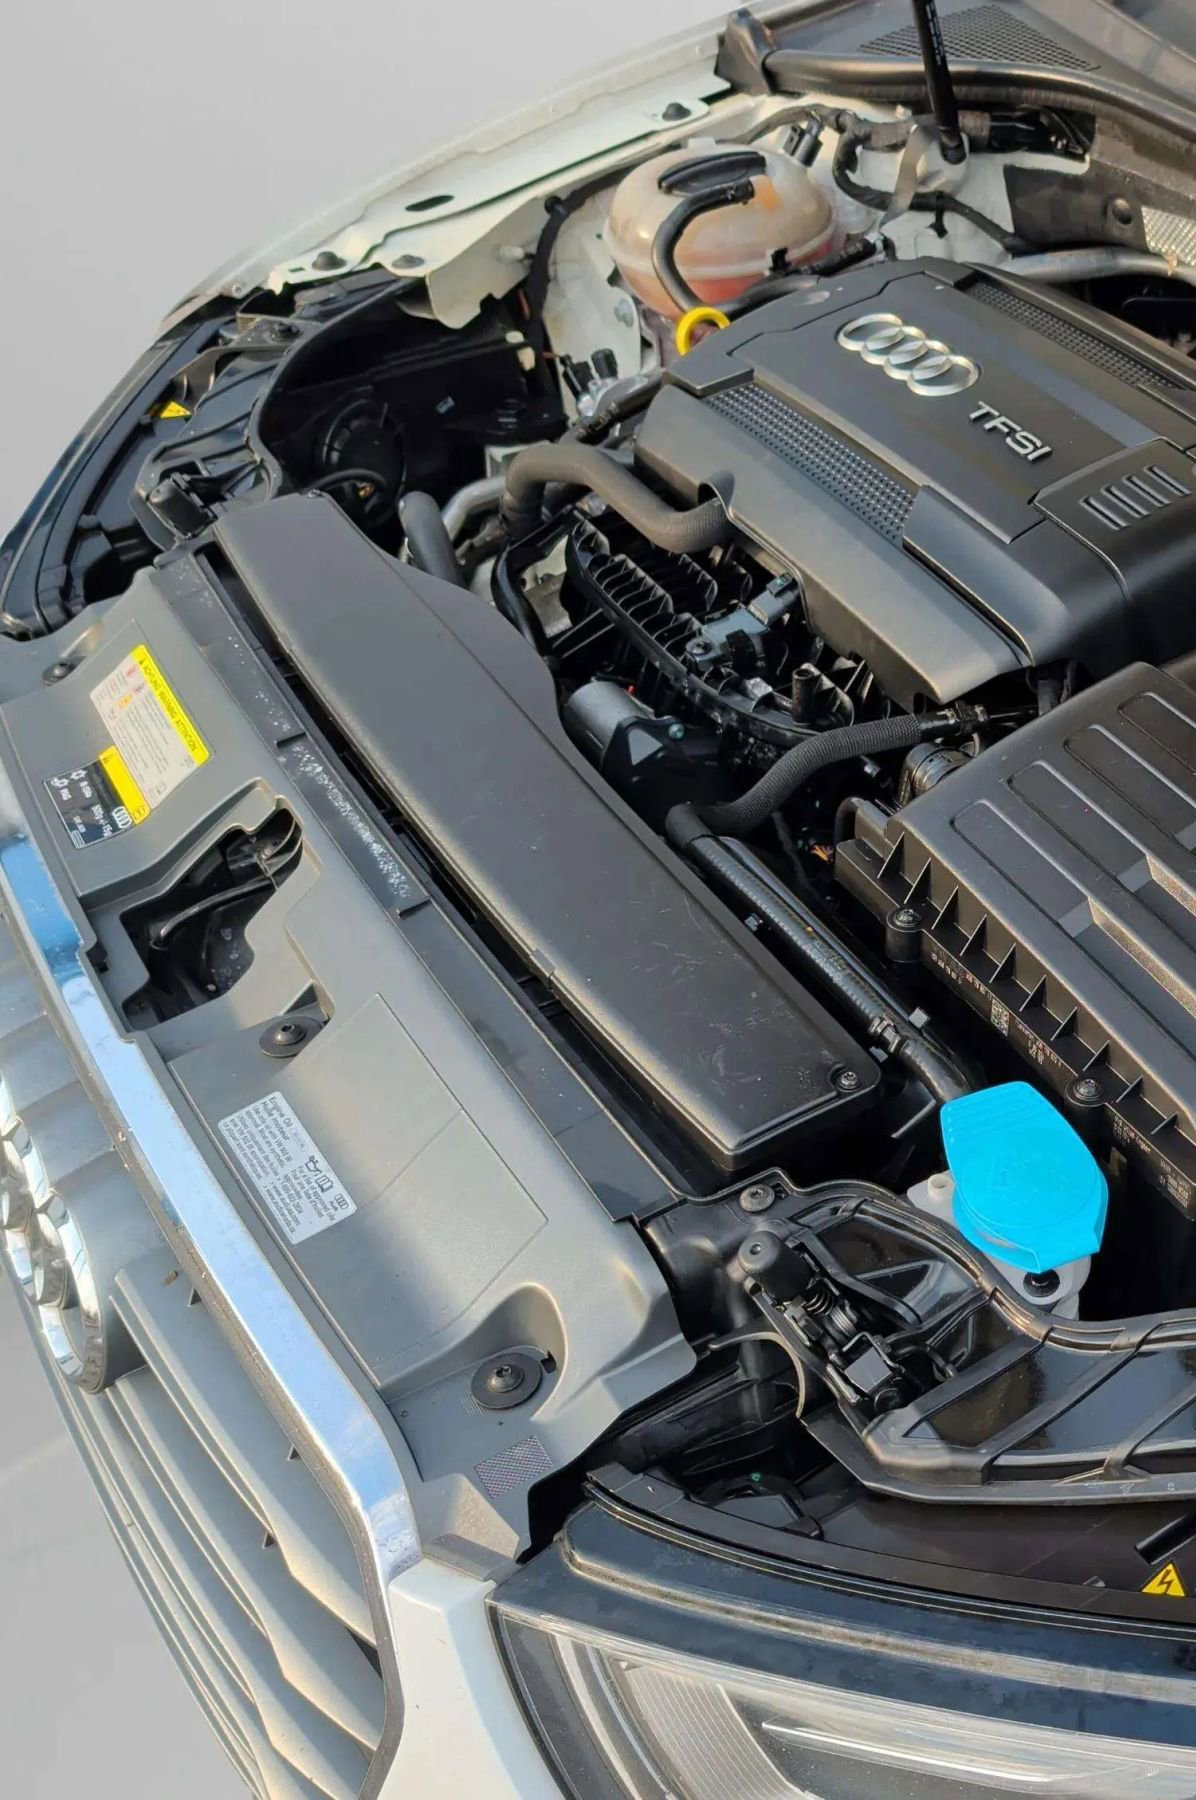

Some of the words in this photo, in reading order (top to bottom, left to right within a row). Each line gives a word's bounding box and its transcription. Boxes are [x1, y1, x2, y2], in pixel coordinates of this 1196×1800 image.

[969, 400, 1052, 463] TFSI
[175, 719, 198, 752] ATTENTION
[271, 1117, 289, 1141] moteur
